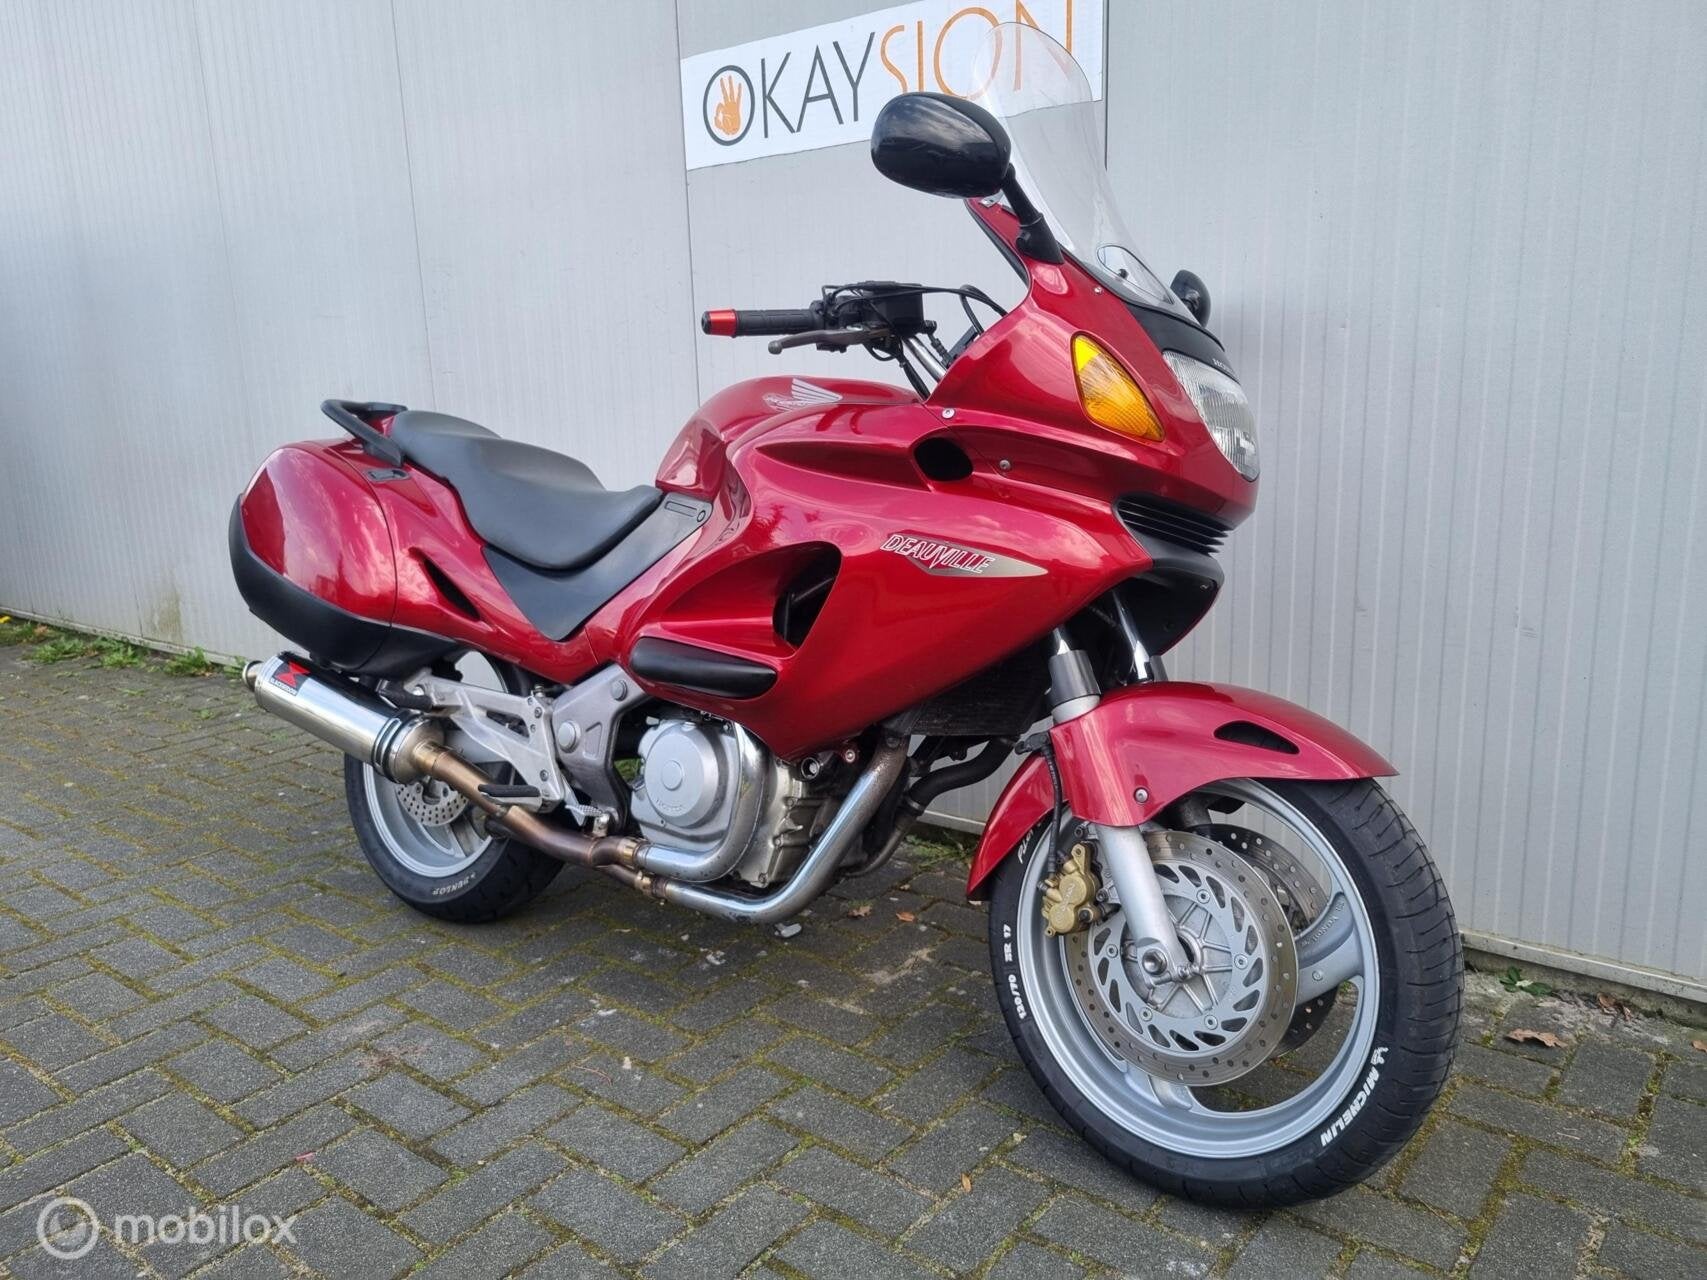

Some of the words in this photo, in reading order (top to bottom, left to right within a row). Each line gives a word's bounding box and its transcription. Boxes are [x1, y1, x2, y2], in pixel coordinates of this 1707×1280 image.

[703, 0, 1073, 146] OKAYSION
[880, 534, 996, 574] DEAUVILLE
[432, 875, 471, 896] DUNLOP
[1003, 923, 1012, 939] 17
[1008, 974, 1027, 1020] 120/70
[1320, 1066, 1380, 1147] MICHELIN
